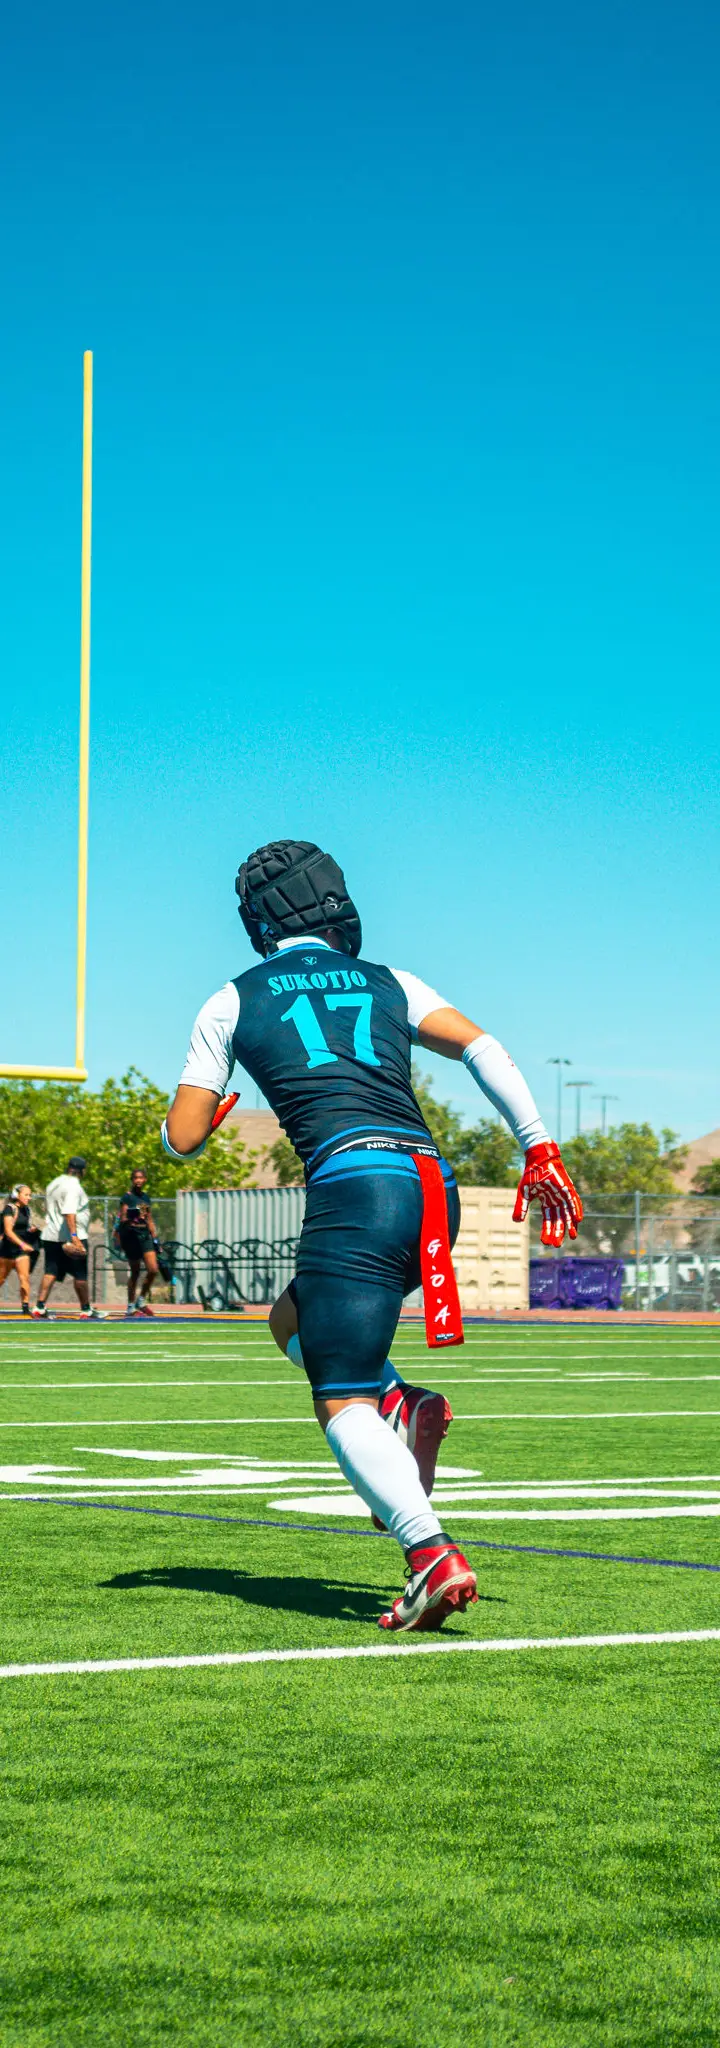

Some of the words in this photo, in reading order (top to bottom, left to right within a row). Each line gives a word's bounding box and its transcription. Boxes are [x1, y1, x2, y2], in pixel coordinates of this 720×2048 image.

[267, 970, 367, 996] SUKOTJO
[280, 993, 381, 1069] 17
[366, 1141, 398, 1150] NIKE
[416, 1147, 440, 1157] NIKE
